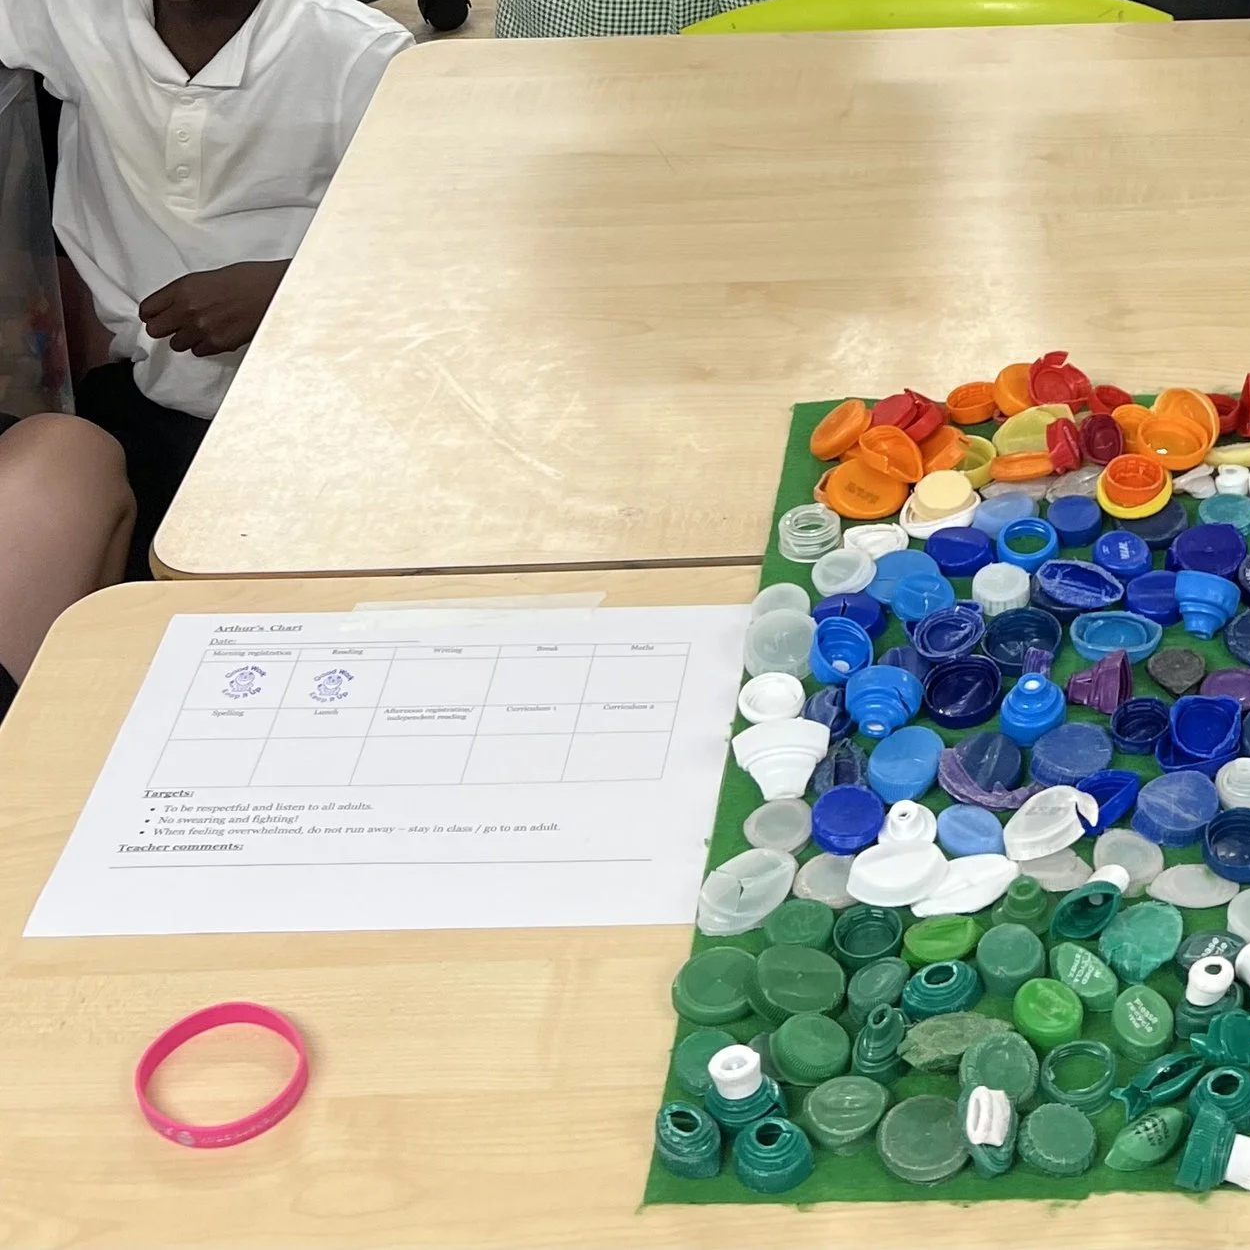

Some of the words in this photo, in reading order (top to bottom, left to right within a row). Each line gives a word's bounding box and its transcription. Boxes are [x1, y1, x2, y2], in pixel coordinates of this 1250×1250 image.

[214, 625, 265, 633] Arthur's
[270, 624, 303, 632] Chart
[209, 638, 237, 646] Date:
[247, 649, 292, 657] registration
[603, 703, 648, 711] Curriculum
[211, 709, 244, 717] Spelling
[143, 790, 195, 799] Targets:
[164, 805, 178, 813] To
[180, 804, 194, 812] be
[196, 803, 250, 814] respectful
[252, 803, 273, 812] and
[275, 803, 305, 811] listen
[321, 803, 335, 811] all
[337, 802, 374, 811] adults.
[158, 816, 175, 824] No
[176, 817, 226, 826] swearing
[228, 815, 250, 824] and
[252, 815, 300, 825] fighting!
[153, 828, 186, 836] When
[188, 827, 226, 836] feeling
[227, 826, 304, 836] overwhelmed,
[307, 826, 322, 835] do
[324, 826, 343, 834] not
[367, 826, 395, 835] away
[407, 825, 430, 834] stay
[433, 824, 444, 832] in
[446, 824, 473, 832] class
[483, 825, 497, 834] go
[500, 824, 511, 832] to
[529, 823, 560, 832] adult.
[118, 843, 169, 853] Teacher
[172, 842, 244, 852] comments:
